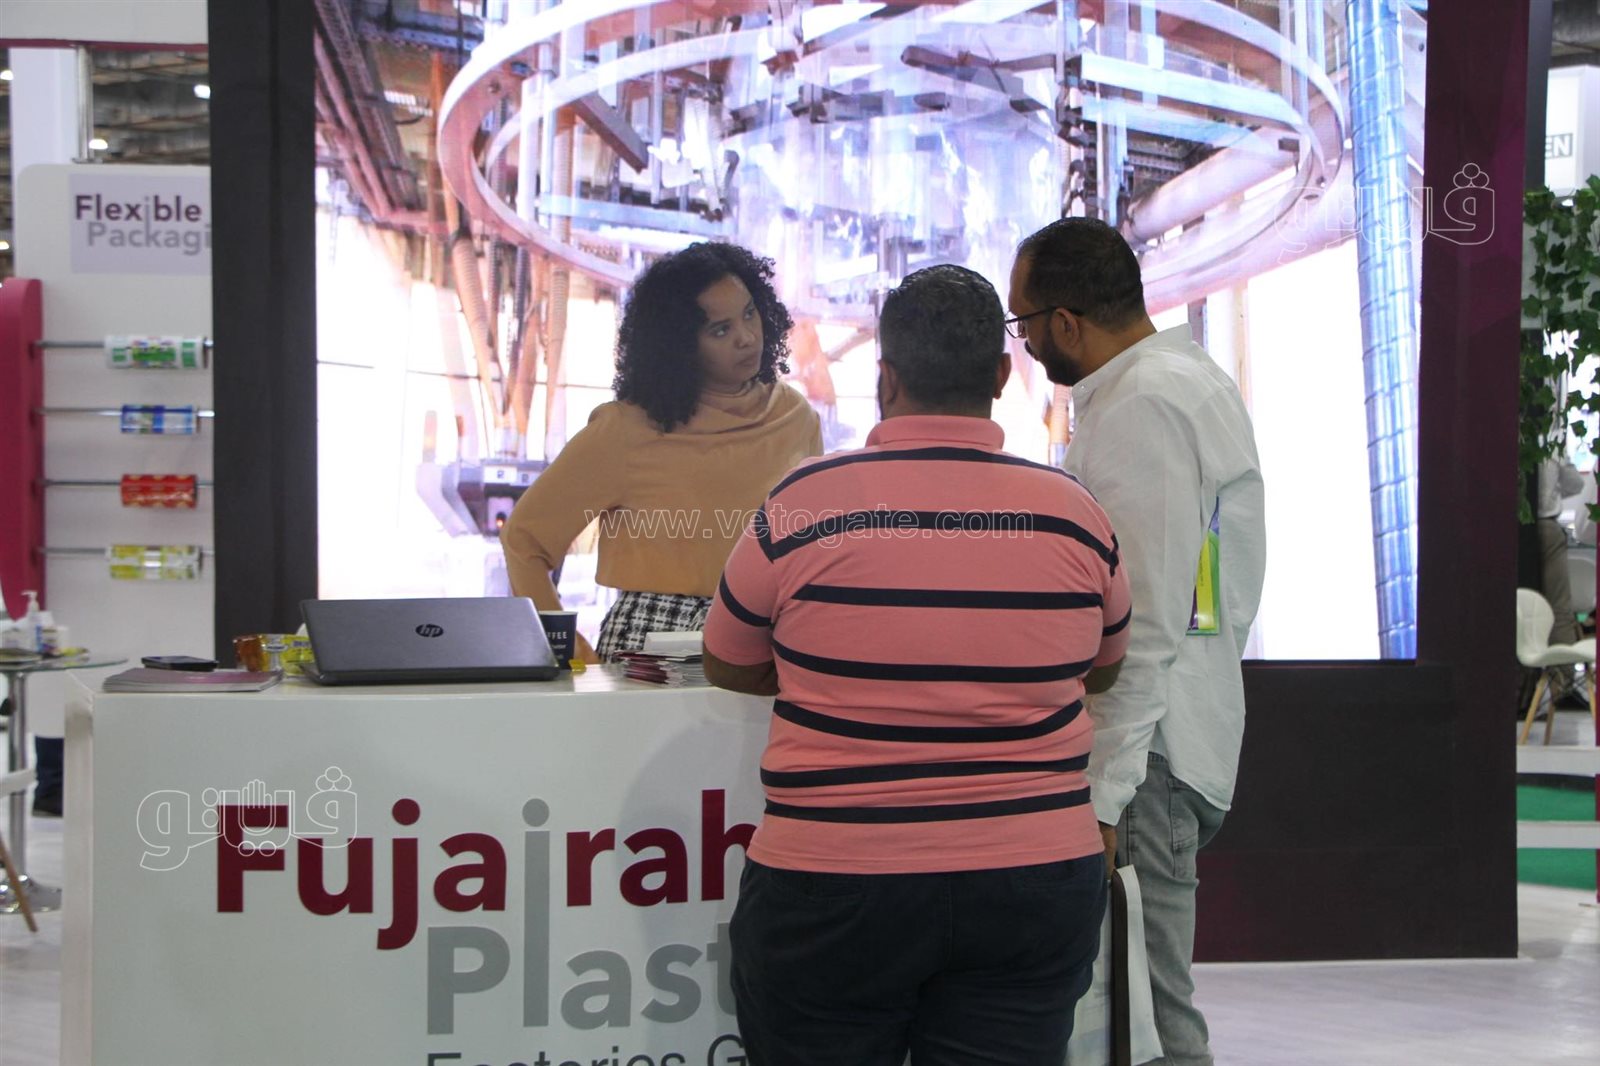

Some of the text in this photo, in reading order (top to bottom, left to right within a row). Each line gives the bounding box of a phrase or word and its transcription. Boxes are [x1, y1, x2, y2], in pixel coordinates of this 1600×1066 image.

[75, 193, 202, 222] Flexible
[418, 624, 442, 638] hp
[216, 788, 757, 950] Fujairah
